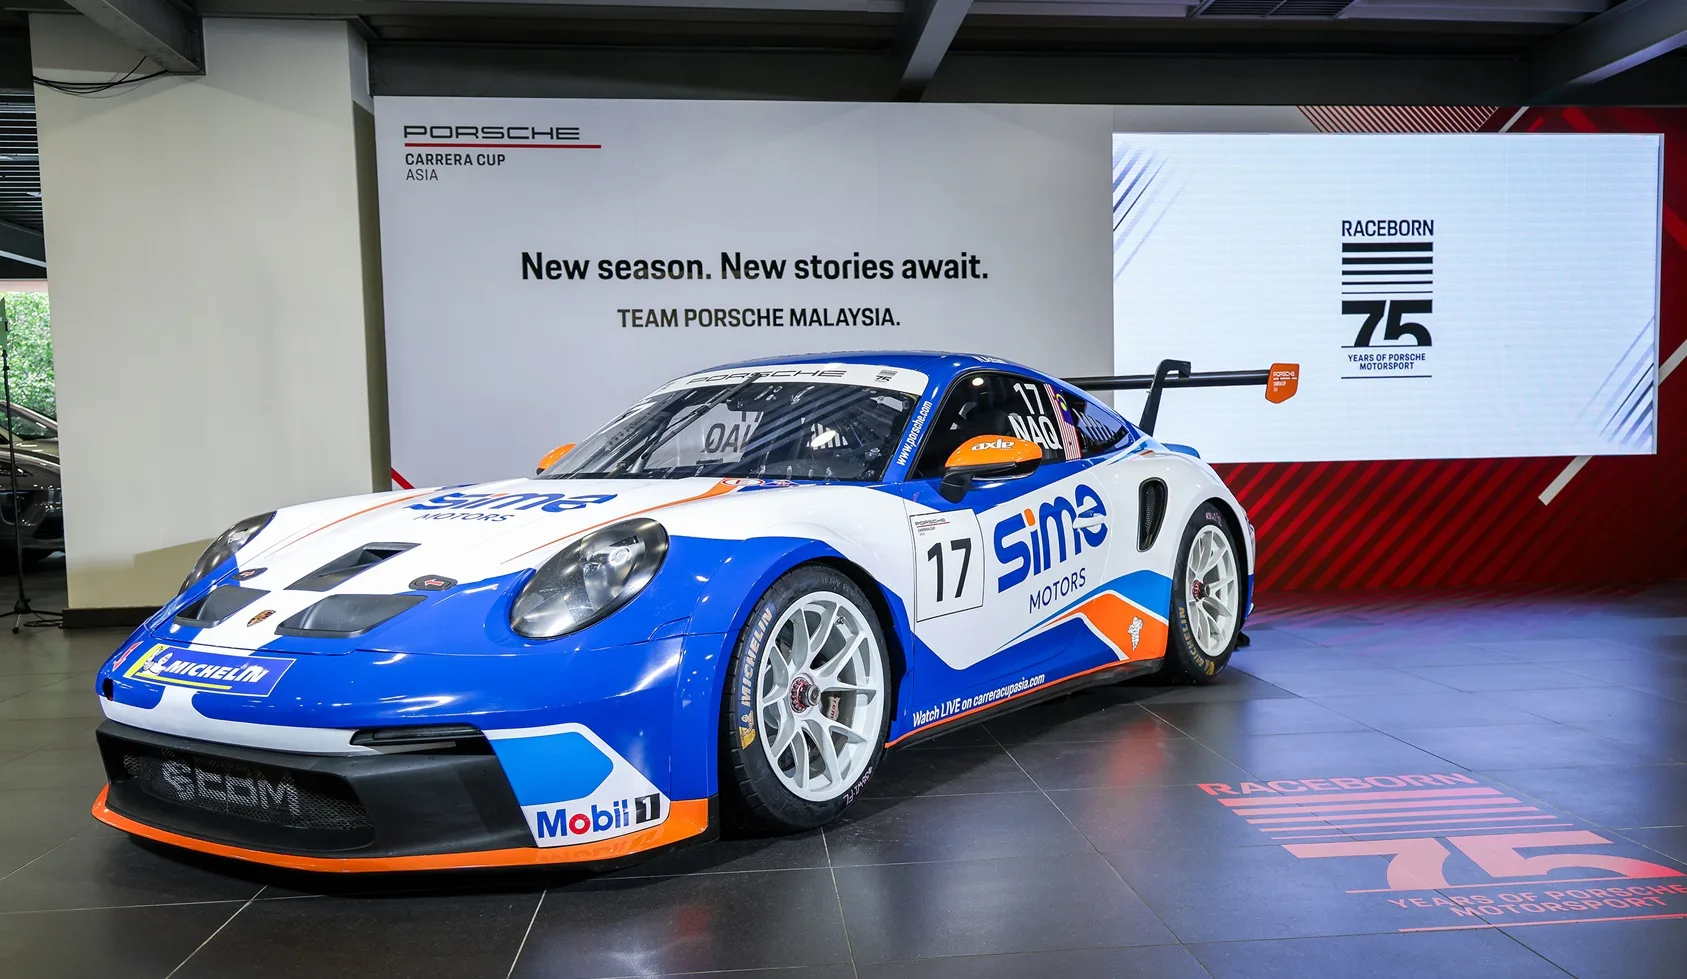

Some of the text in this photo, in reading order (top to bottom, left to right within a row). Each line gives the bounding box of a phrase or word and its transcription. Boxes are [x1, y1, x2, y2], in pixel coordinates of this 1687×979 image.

[404, 125, 580, 140] PORSCHE
[405, 153, 506, 166] CARRERA CUP
[406, 168, 439, 181] ASIA
[1341, 219, 1435, 237] RACEBORN
[521, 251, 989, 280] New season. New stories await.
[617, 307, 901, 328] TEAM PORSCHE MALAYSIA.
[1341, 299, 1434, 347] 75
[1348, 353, 1426, 362] YEARS OF PORSCHE
[1359, 362, 1414, 370] MOTORSPORT
[1013, 383, 1045, 414] 17
[896, 400, 933, 466] www.porsche.com
[971, 438, 1016, 451] axle
[1008, 415, 1063, 450] NAQ
[413, 512, 515, 522] MOTORS
[927, 537, 972, 602] 17
[1029, 567, 1087, 614] MOTORS
[741, 607, 774, 708] MICHELIN
[165, 660, 270, 683] MICHELIN
[912, 673, 1046, 728] Watch LIVE on carreracupasia.com
[1196, 772, 1478, 796] RACEBORN
[536, 799, 630, 838] Mobil
[1281, 830, 1687, 891] 75
[1387, 884, 1687, 909] YEARS OF PORSCHE
[1448, 895, 1669, 917] MOTORSPORT
